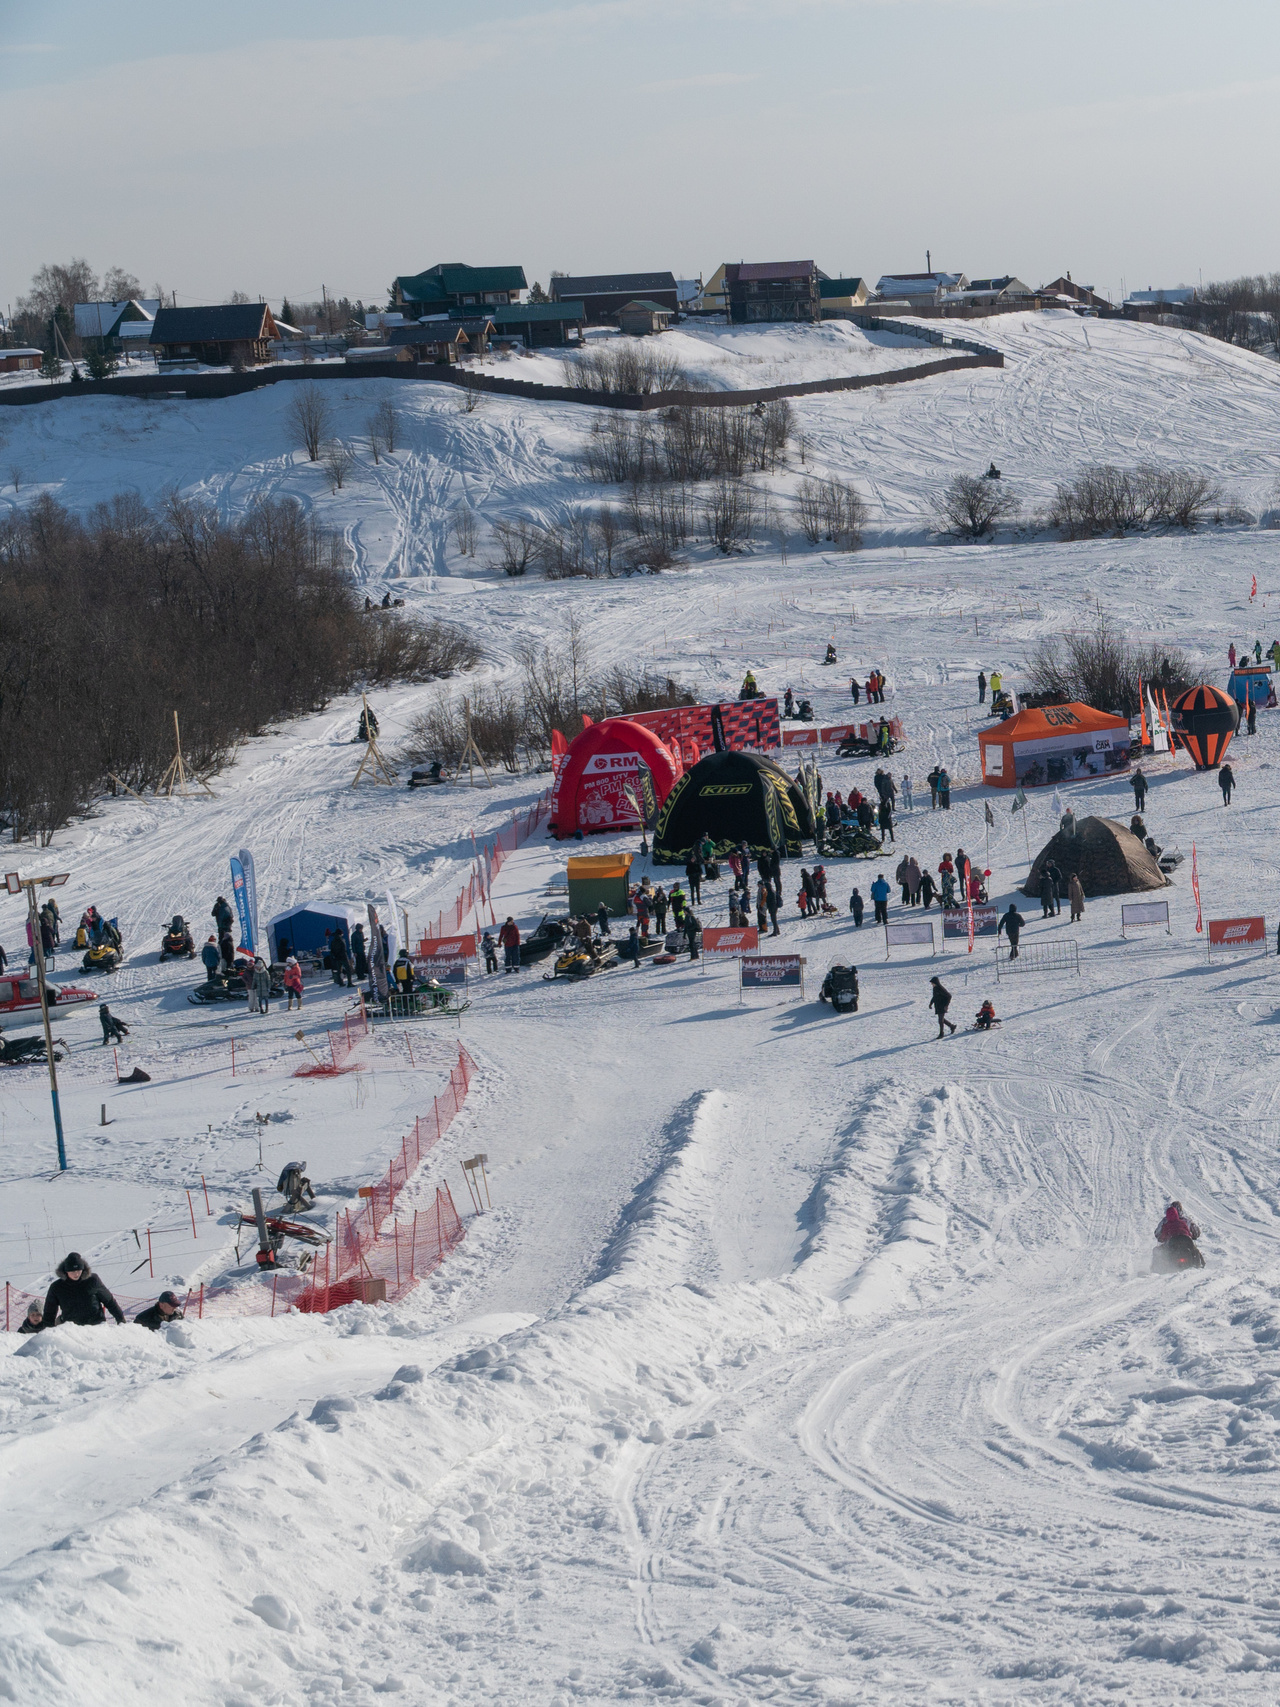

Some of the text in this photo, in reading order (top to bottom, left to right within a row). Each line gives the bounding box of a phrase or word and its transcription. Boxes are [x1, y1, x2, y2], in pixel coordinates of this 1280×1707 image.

[610, 756, 639, 768] RM
[613, 772, 629, 780] UTV
[422, 968, 449, 976] KAYAK
